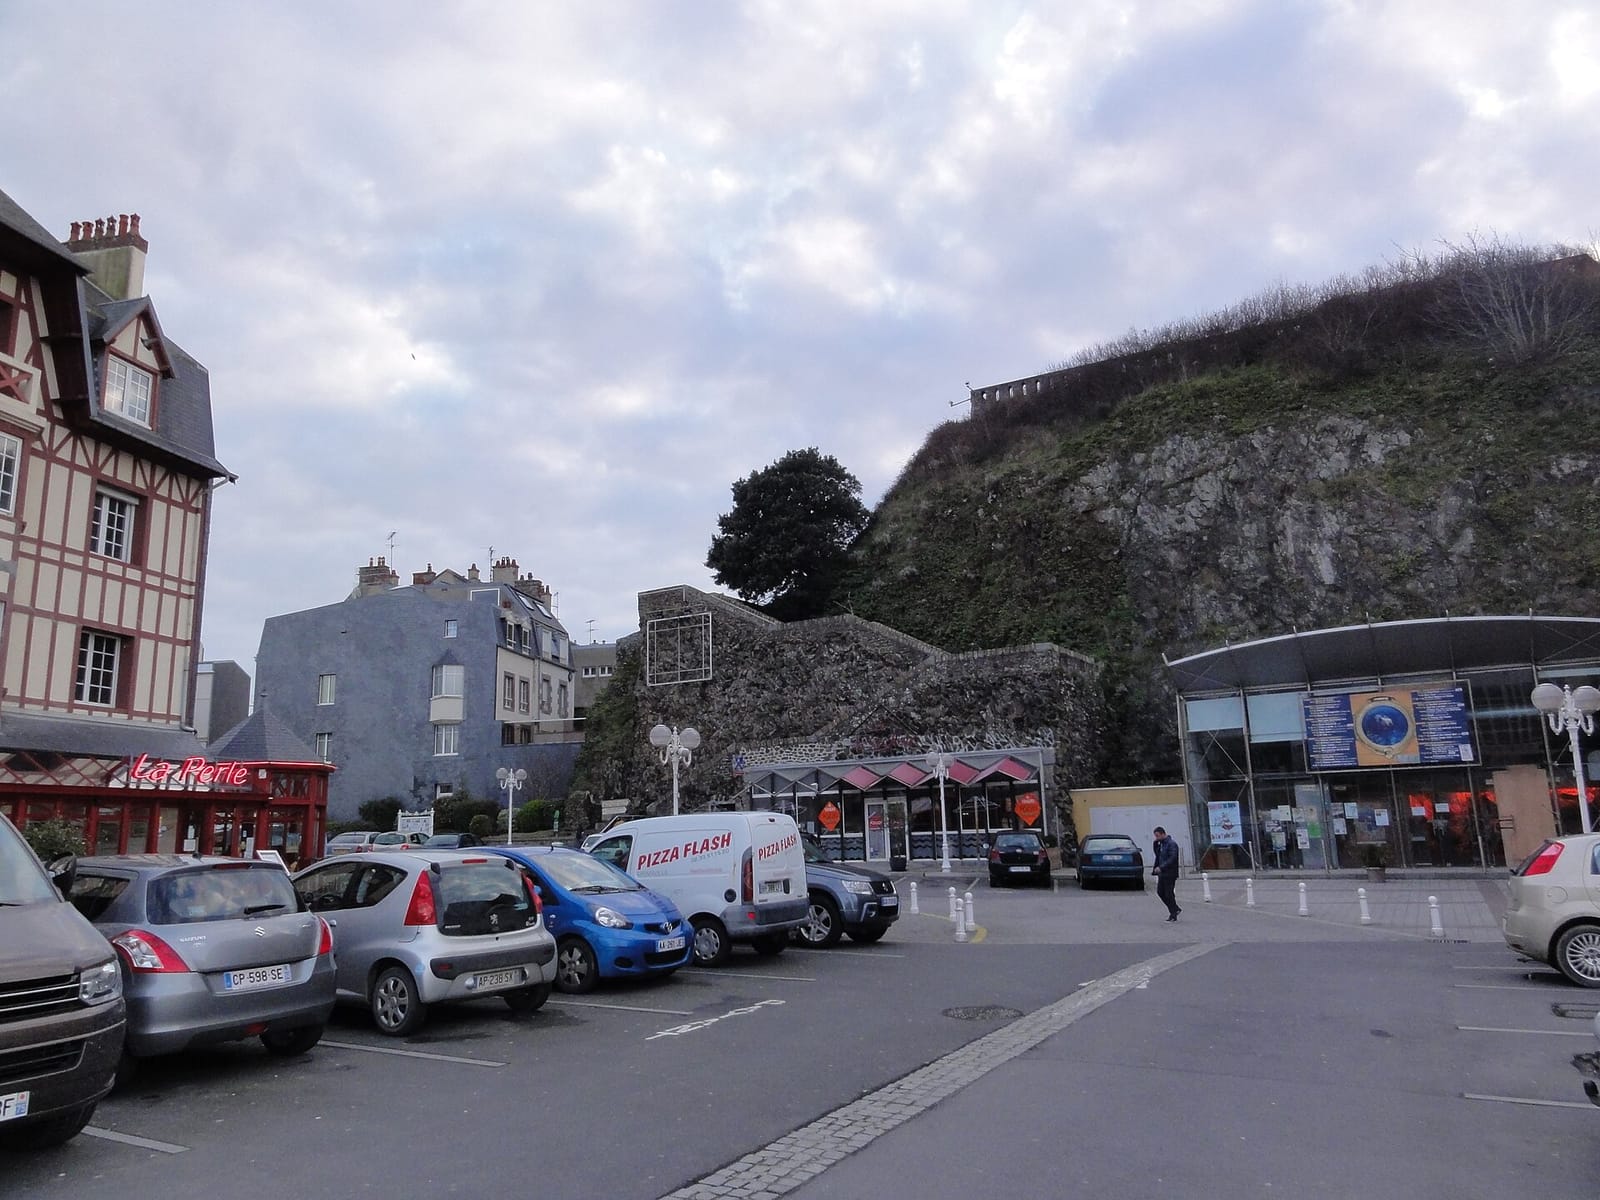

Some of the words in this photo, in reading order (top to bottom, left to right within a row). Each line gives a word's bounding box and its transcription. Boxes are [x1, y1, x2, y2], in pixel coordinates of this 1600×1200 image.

[130, 753, 170, 781] La
[179, 756, 248, 784] Perle
[637, 846, 679, 870] PIZZA
[683, 832, 731, 857] FLASH
[758, 842, 779, 860] PIZZA
[780, 834, 797, 851] FLASH
